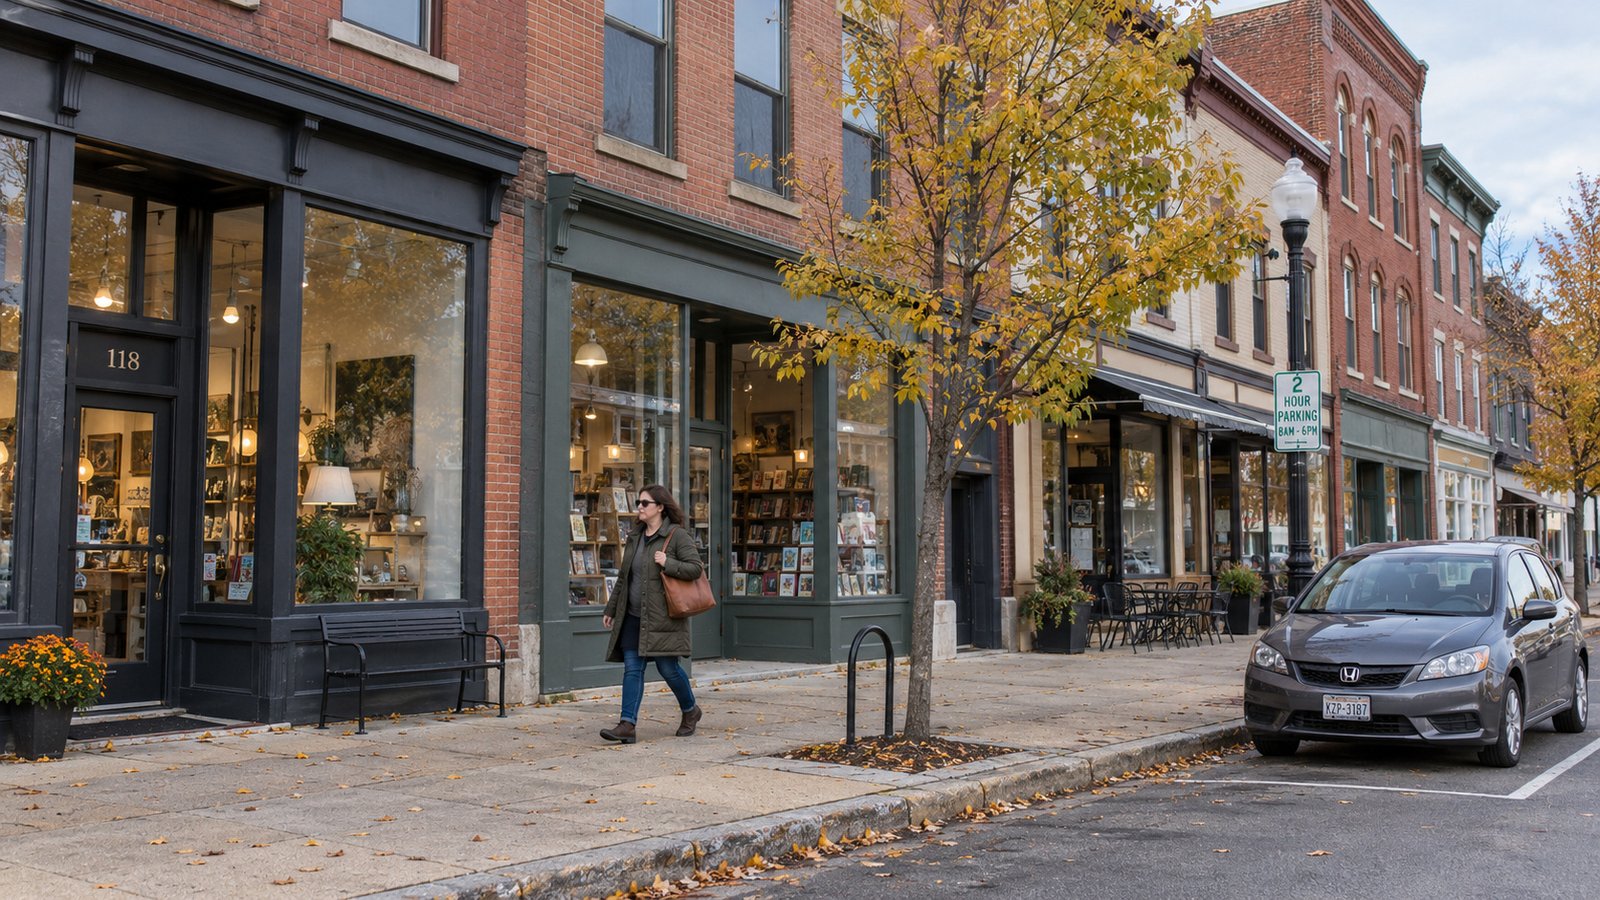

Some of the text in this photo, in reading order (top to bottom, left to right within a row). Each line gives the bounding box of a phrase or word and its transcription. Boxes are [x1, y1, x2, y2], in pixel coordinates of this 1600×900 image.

[108, 349, 140, 370] 118
[1292, 376, 1303, 393] 2
[1284, 395, 1311, 407] HOUR
[1278, 410, 1318, 422] PARKING
[1278, 426, 1295, 437] 8AM
[1301, 425, 1318, 436] 6PM
[1325, 702, 1367, 715] KZP-3187
